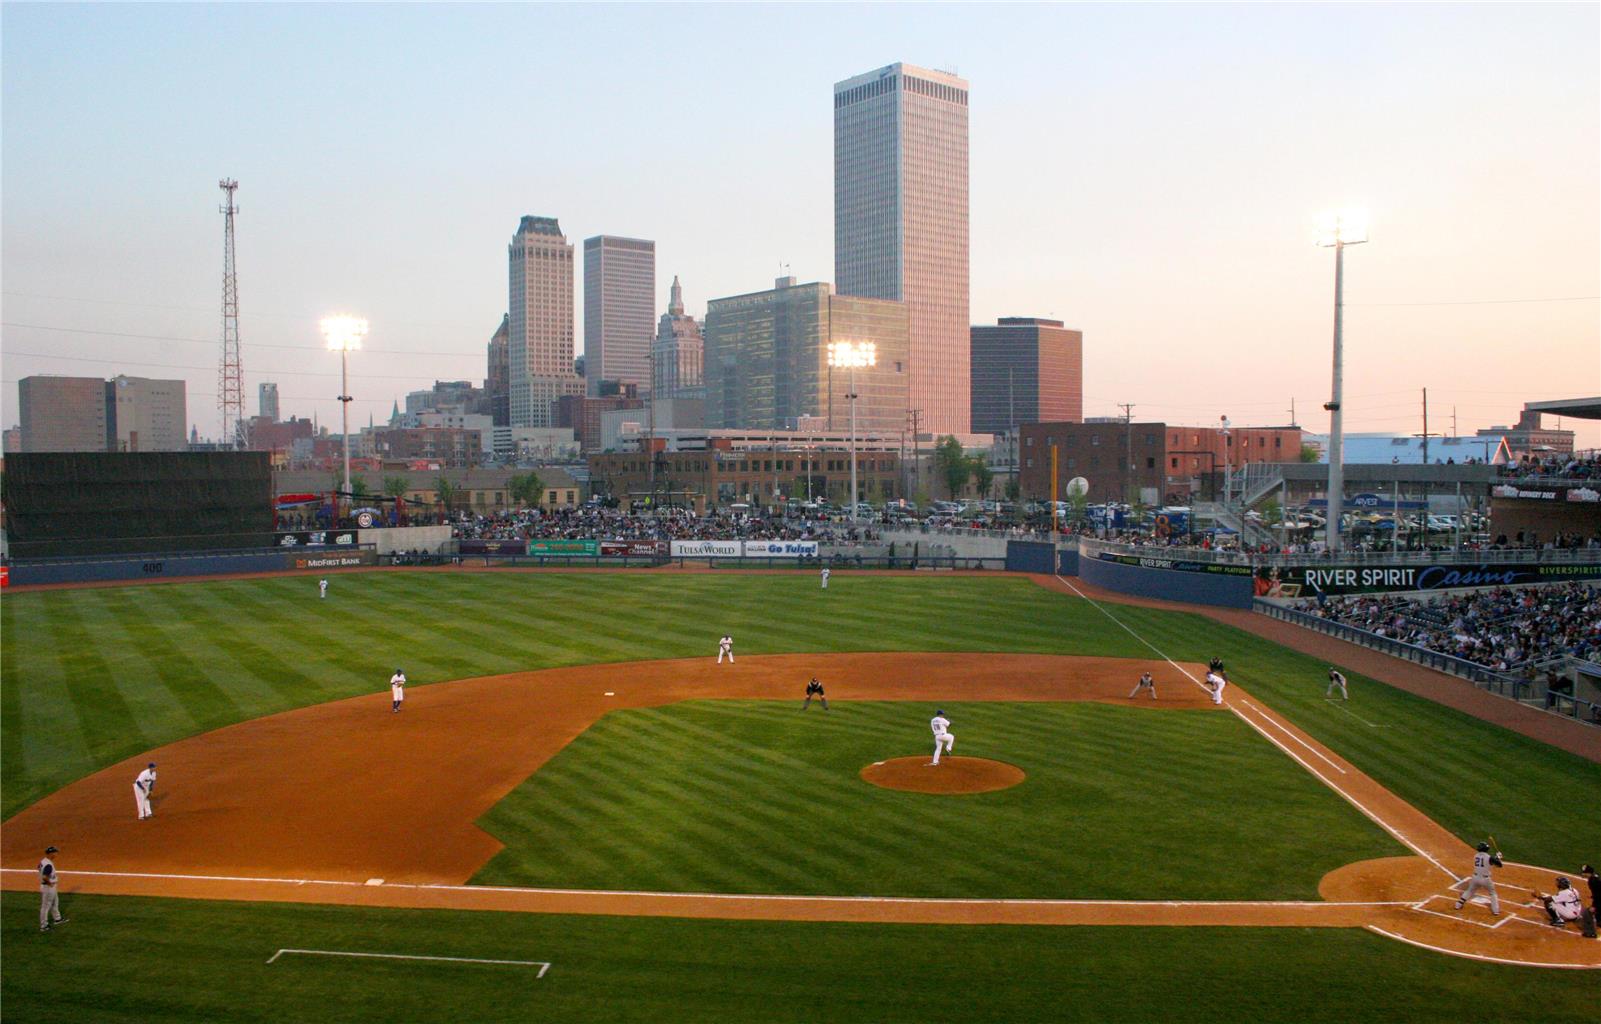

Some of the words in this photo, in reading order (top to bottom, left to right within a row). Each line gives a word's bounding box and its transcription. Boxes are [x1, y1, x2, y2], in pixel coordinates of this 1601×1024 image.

[678, 545, 702, 554] TULSA
[704, 545, 735, 554] WORLD
[768, 544, 783, 553] Go
[785, 544, 816, 553] Tulsa!
[143, 562, 162, 572] 400
[1140, 559, 1155, 567] RIVER
[1156, 560, 1172, 568] SPIRIT
[1539, 566, 1601, 575] RIVERSPIRIT
[1305, 569, 1358, 592] RIVER
[1362, 569, 1415, 586] SPIRIT
[1417, 565, 1532, 590] Casino
[1474, 857, 1485, 867] 21
